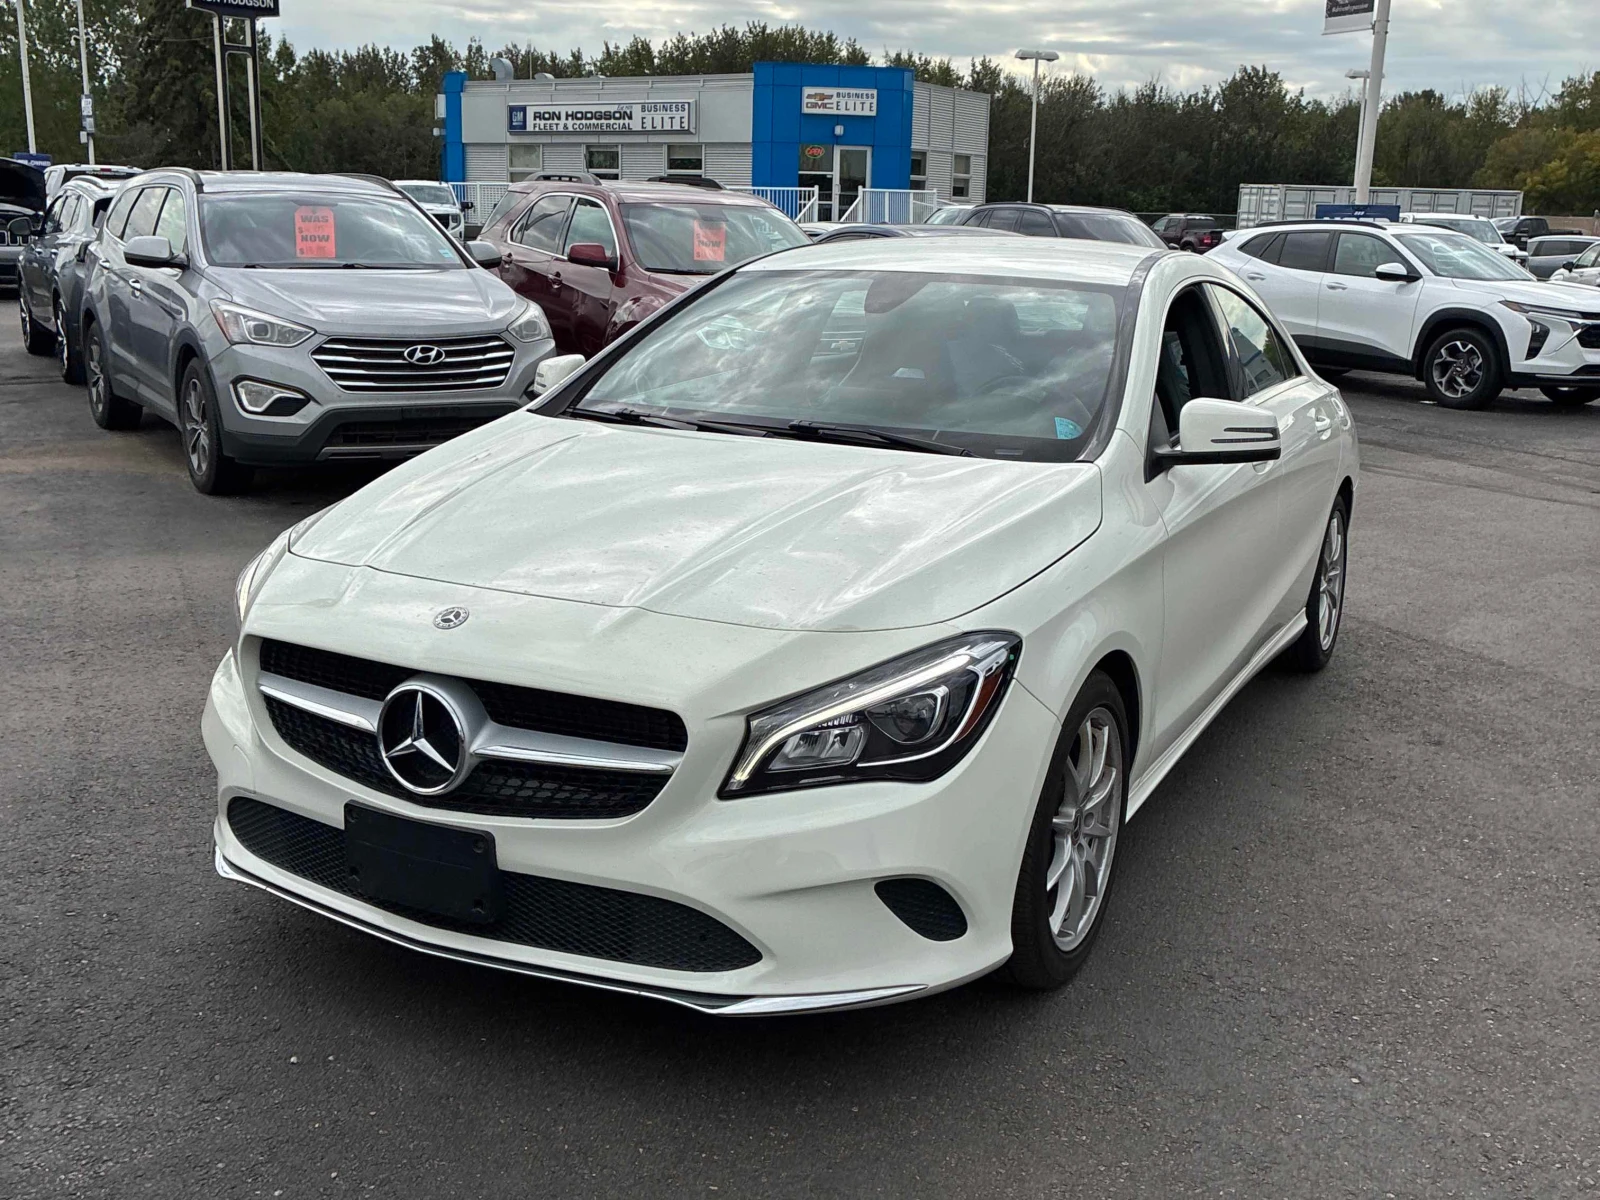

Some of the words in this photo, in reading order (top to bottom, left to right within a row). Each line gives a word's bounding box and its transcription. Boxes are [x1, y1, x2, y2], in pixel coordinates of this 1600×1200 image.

[836, 92, 875, 100] BUSINESS
[641, 104, 686, 113] BUSINESS
[805, 102, 834, 110] GMC
[836, 101, 875, 112] ELITE
[512, 111, 524, 122] GM
[533, 111, 561, 121] RON
[565, 110, 633, 121] HODGSON
[533, 122, 560, 131] FLEET
[563, 122, 569, 131] &
[571, 122, 633, 131] COMMERCIAL
[641, 116, 686, 130] ELITE
[300, 215, 329, 223] WAS
[300, 234, 330, 242] NOW
